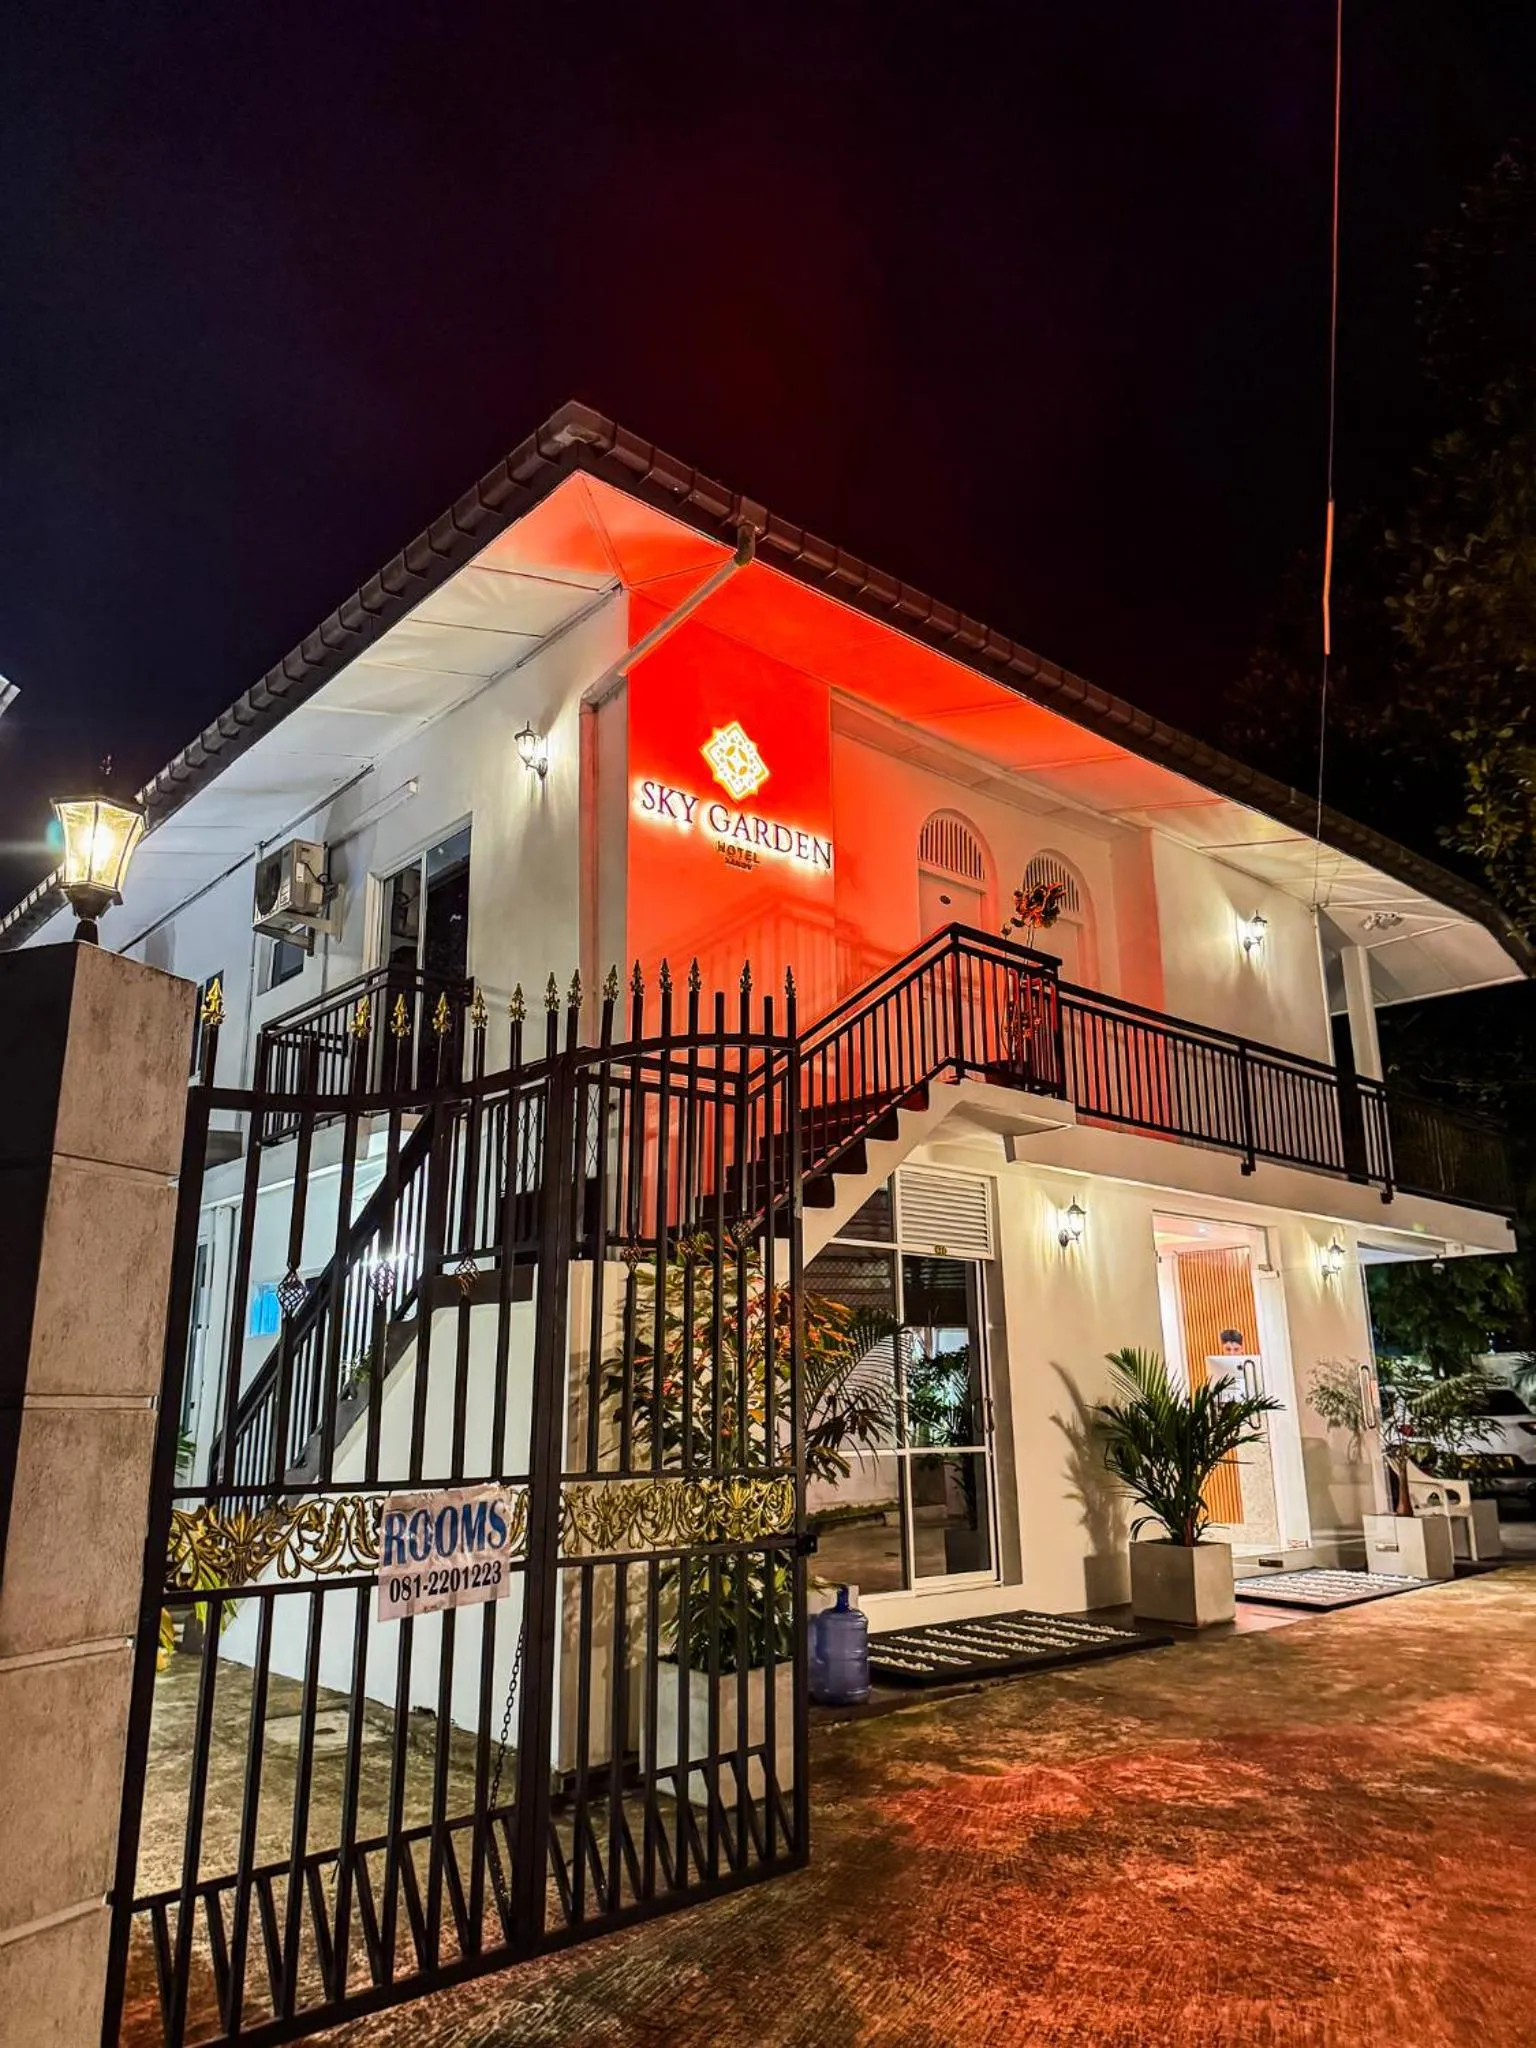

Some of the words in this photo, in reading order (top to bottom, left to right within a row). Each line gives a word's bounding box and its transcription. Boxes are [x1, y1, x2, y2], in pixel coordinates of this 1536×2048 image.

[641, 781, 700, 824] SKY
[709, 803, 833, 869] GARDEN
[716, 841, 761, 864] HOTEL
[383, 1498, 508, 1567] ROOMS
[389, 1560, 502, 1603] 081-2201223
